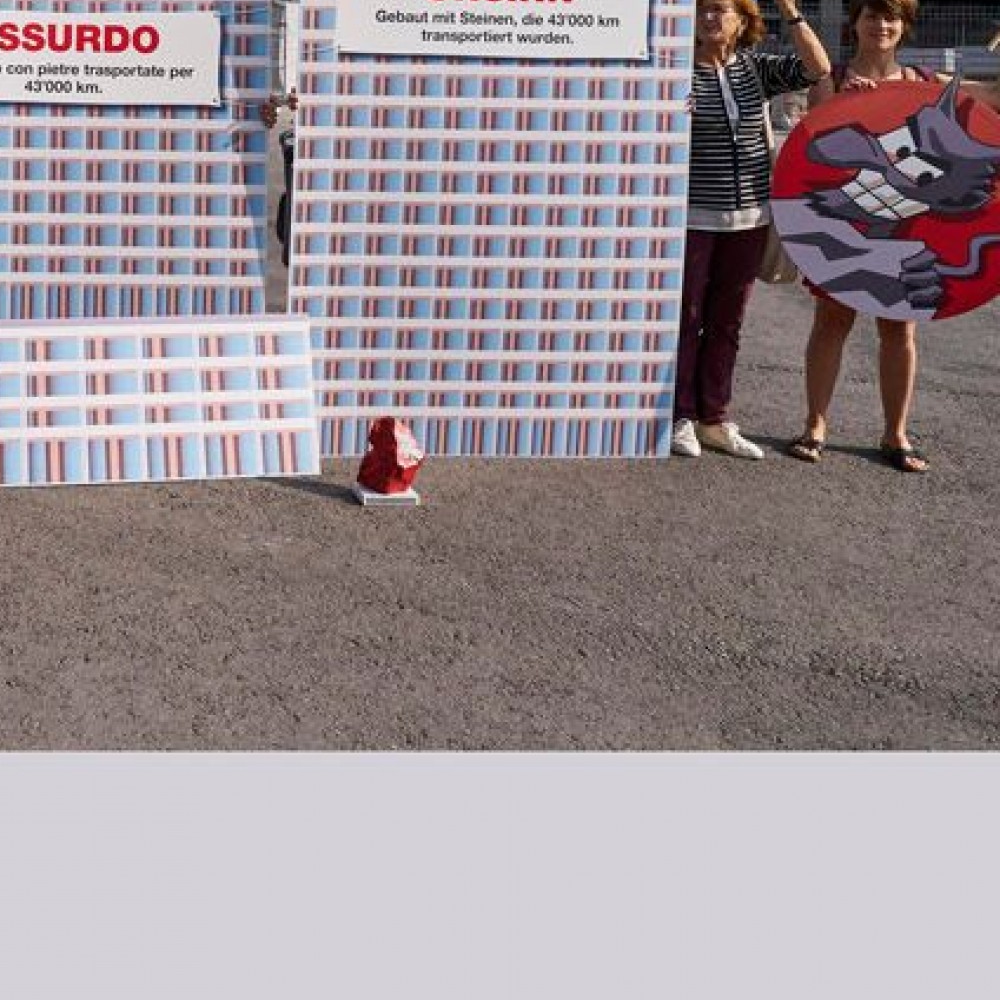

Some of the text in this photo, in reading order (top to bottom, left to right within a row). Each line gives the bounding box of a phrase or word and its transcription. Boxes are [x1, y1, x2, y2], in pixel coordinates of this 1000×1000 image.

[375, 9, 620, 28] Gebaut mit Steinen, die 43'000 km
[422, 29, 575, 45] transportiert wurden.
[6, 64, 35, 76] con
[38, 63, 80, 80] pietre
[83, 63, 165, 80] trasportate
[170, 66, 195, 81] per
[24, 79, 103, 95] 43'000 km.
